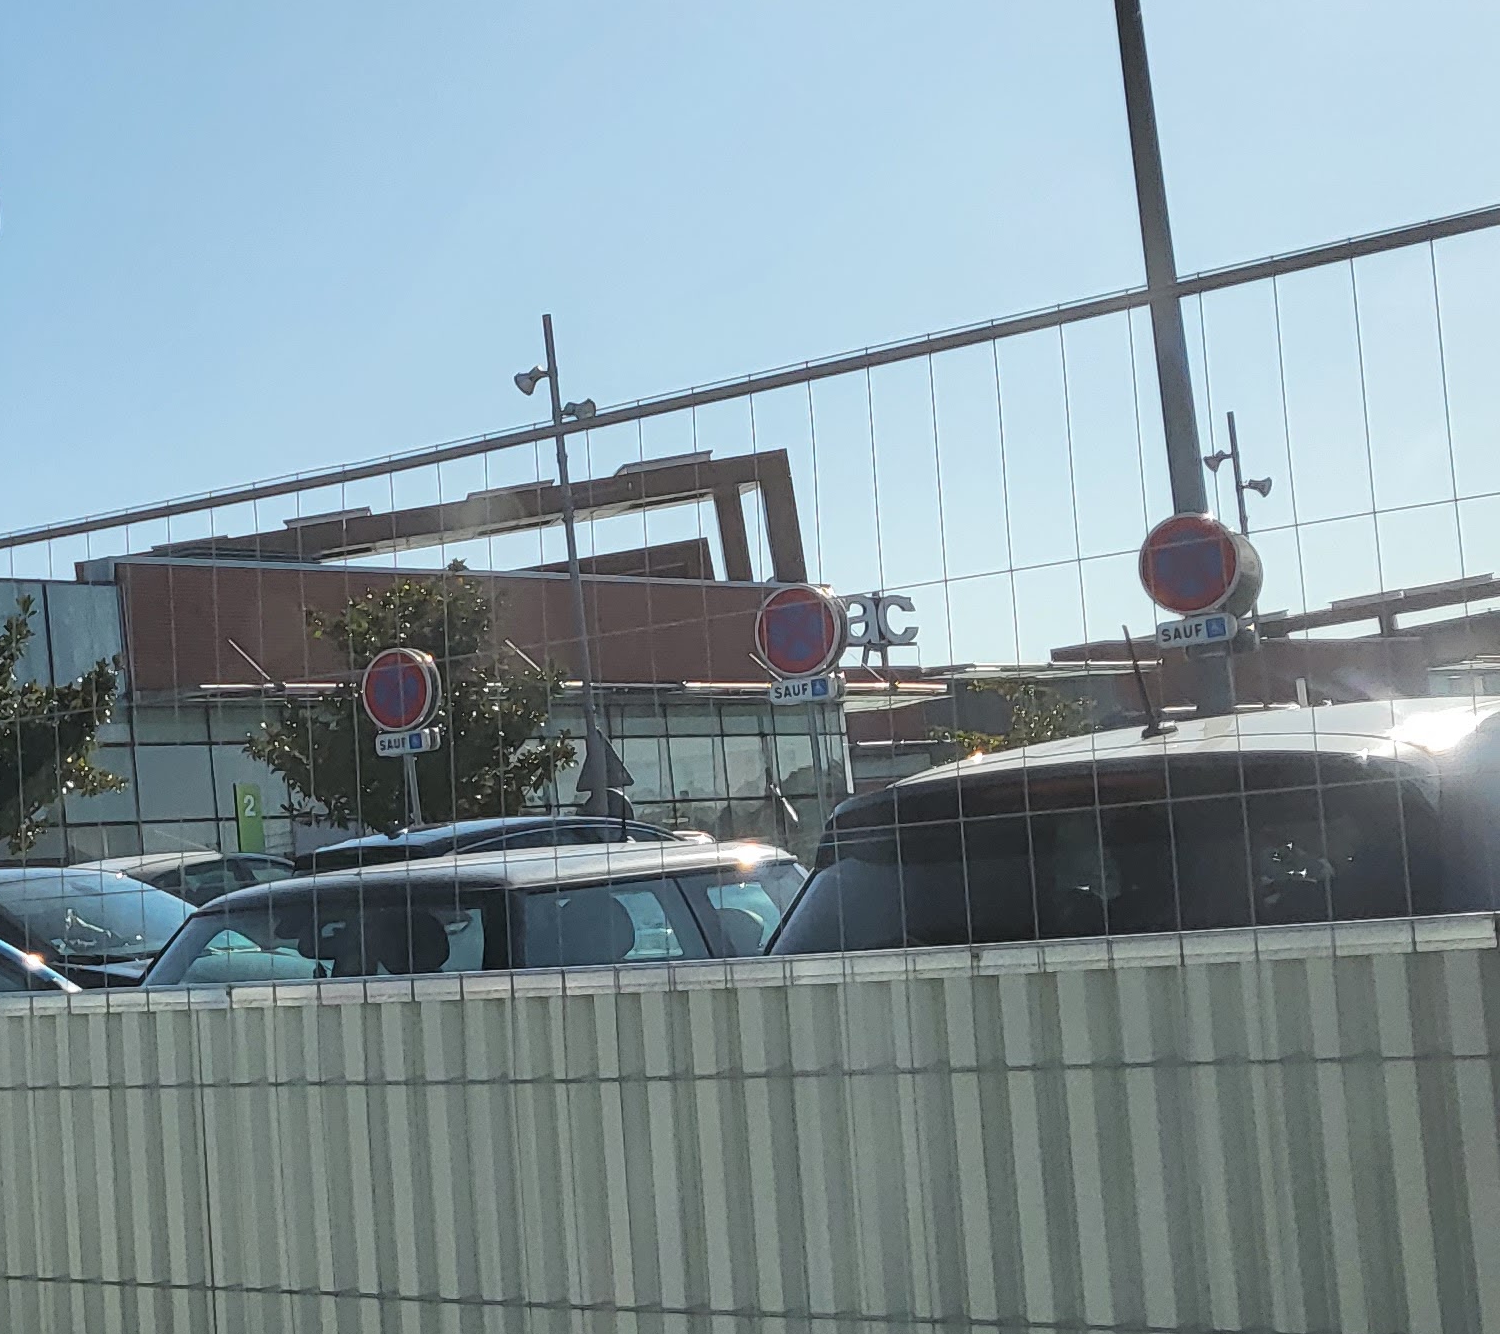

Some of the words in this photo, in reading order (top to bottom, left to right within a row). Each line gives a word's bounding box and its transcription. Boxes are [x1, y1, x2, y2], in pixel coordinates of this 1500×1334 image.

[845, 593, 919, 645] ac
[1161, 623, 1202, 643] SAUF
[774, 682, 808, 699] SAUF
[243, 794, 256, 817] 2
